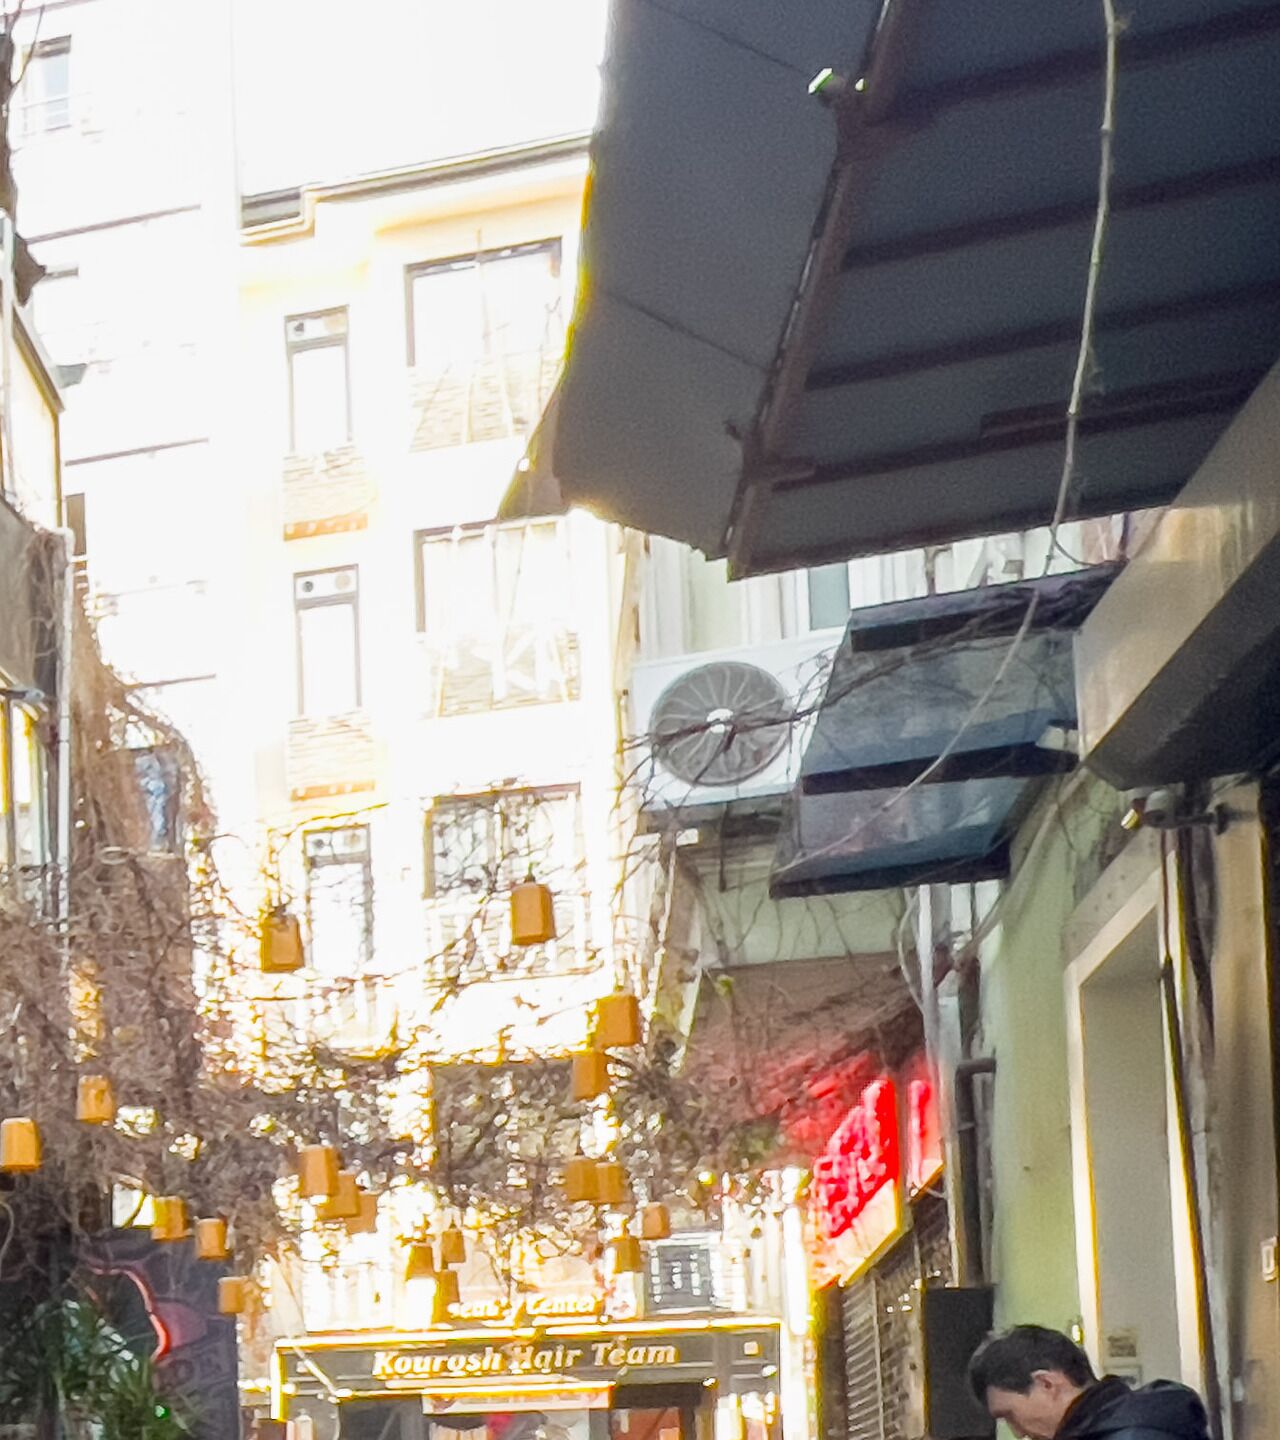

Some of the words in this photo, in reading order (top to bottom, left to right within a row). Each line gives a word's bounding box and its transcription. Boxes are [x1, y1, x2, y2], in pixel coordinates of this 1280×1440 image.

[371, 1346, 502, 1379] Kourosh
[507, 1343, 583, 1374] Hair
[590, 1338, 677, 1367] Team
